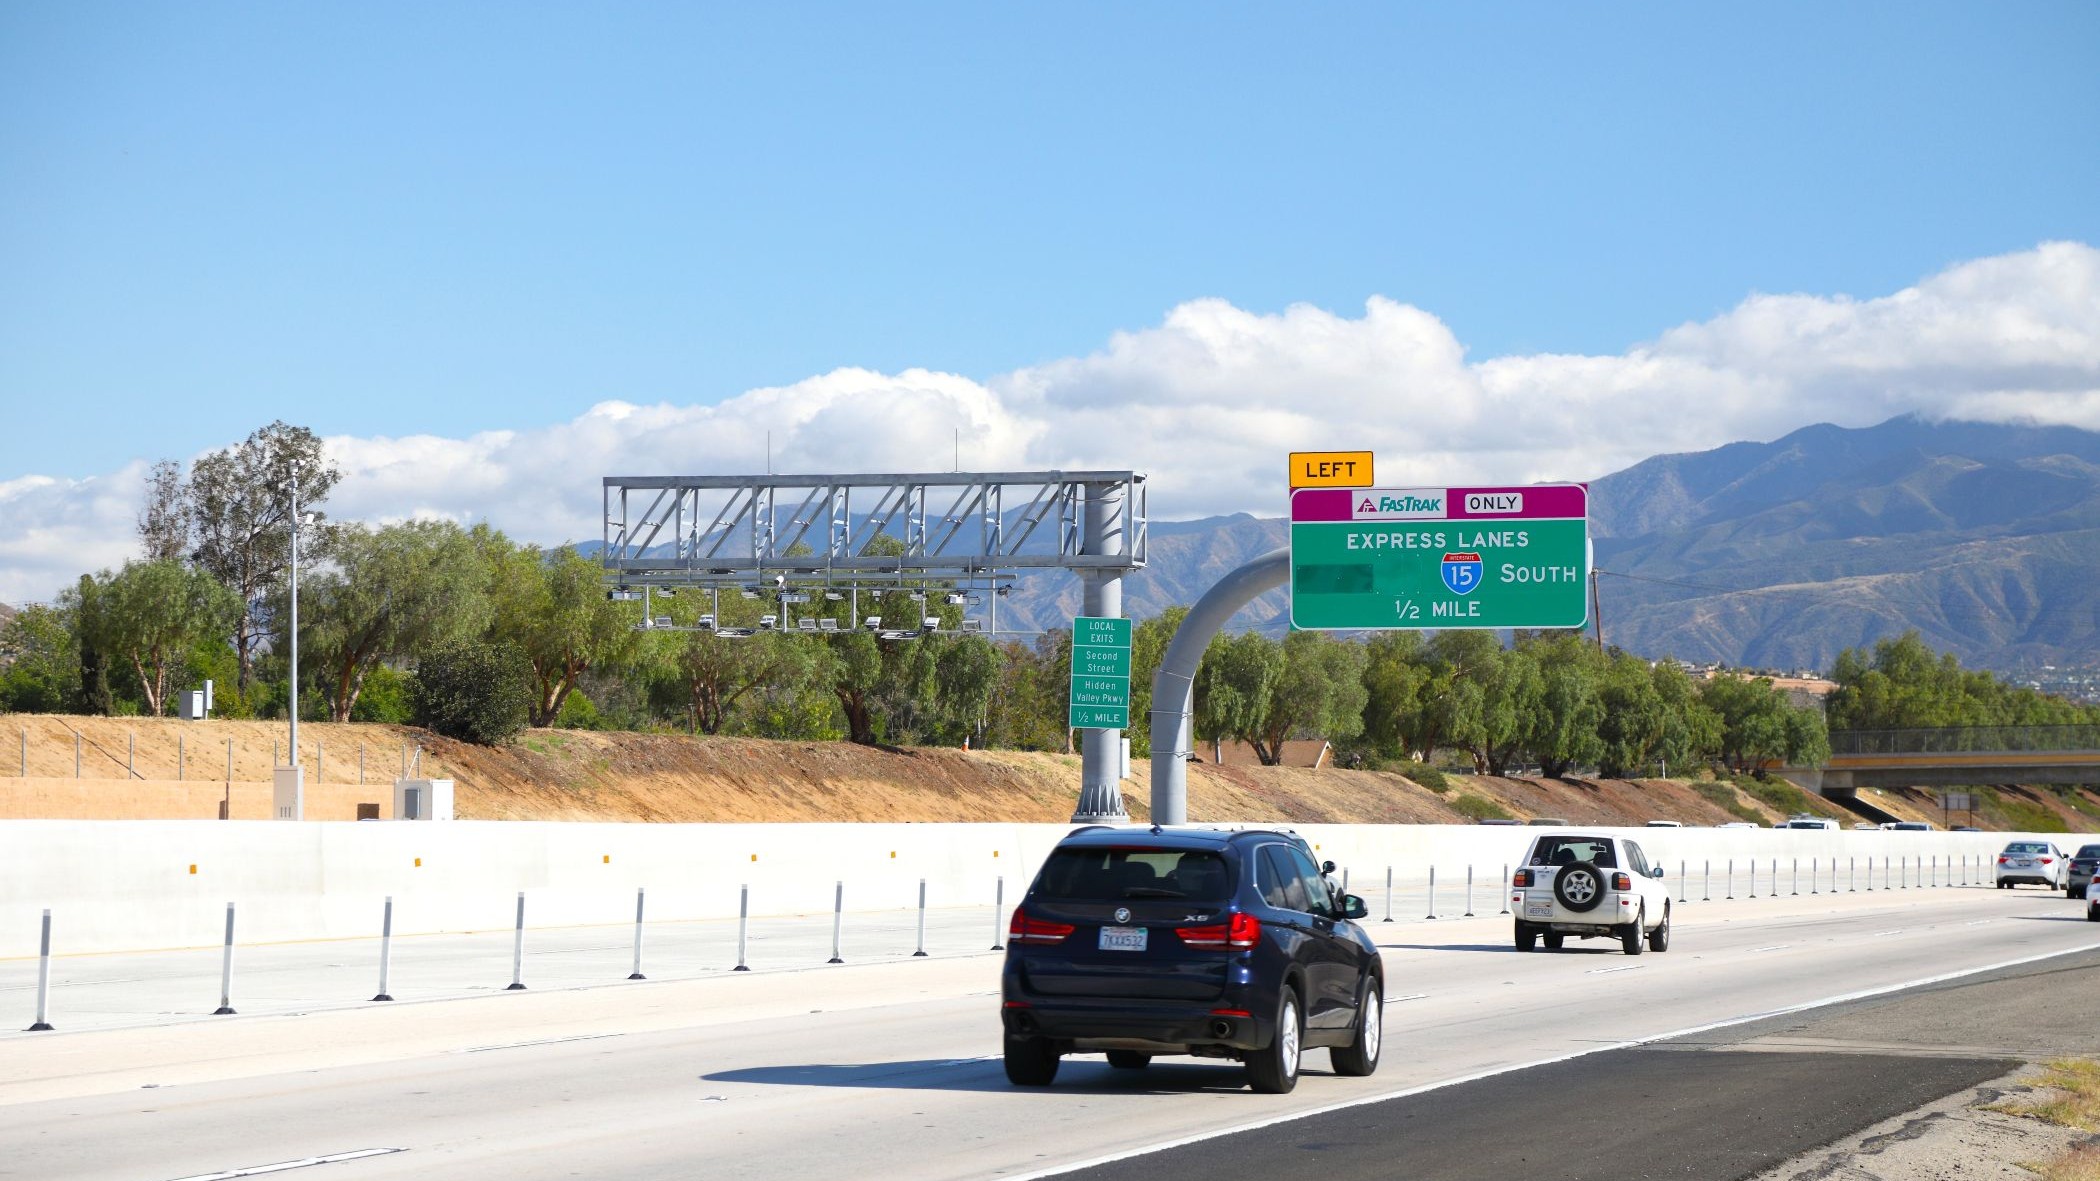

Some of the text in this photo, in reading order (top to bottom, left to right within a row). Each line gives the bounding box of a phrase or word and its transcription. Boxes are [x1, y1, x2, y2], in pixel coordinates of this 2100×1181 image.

[1306, 461, 1356, 478] LEFT
[1469, 496, 1518, 510] ONLY
[1347, 531, 1529, 550] EXPRESS LANES
[1451, 565, 1473, 586] 15
[1500, 563, 1577, 583] SOUTH
[1432, 601, 1481, 617] MILE
[1089, 621, 1116, 631] LOCAL
[1090, 634, 1114, 643] EXITS
[1086, 650, 1118, 660] Second
[1087, 663, 1115, 673] Street
[1085, 680, 1116, 690] Hidden
[1076, 693, 1123, 704] Valley Pkwy
[1094, 713, 1121, 723] MILE
